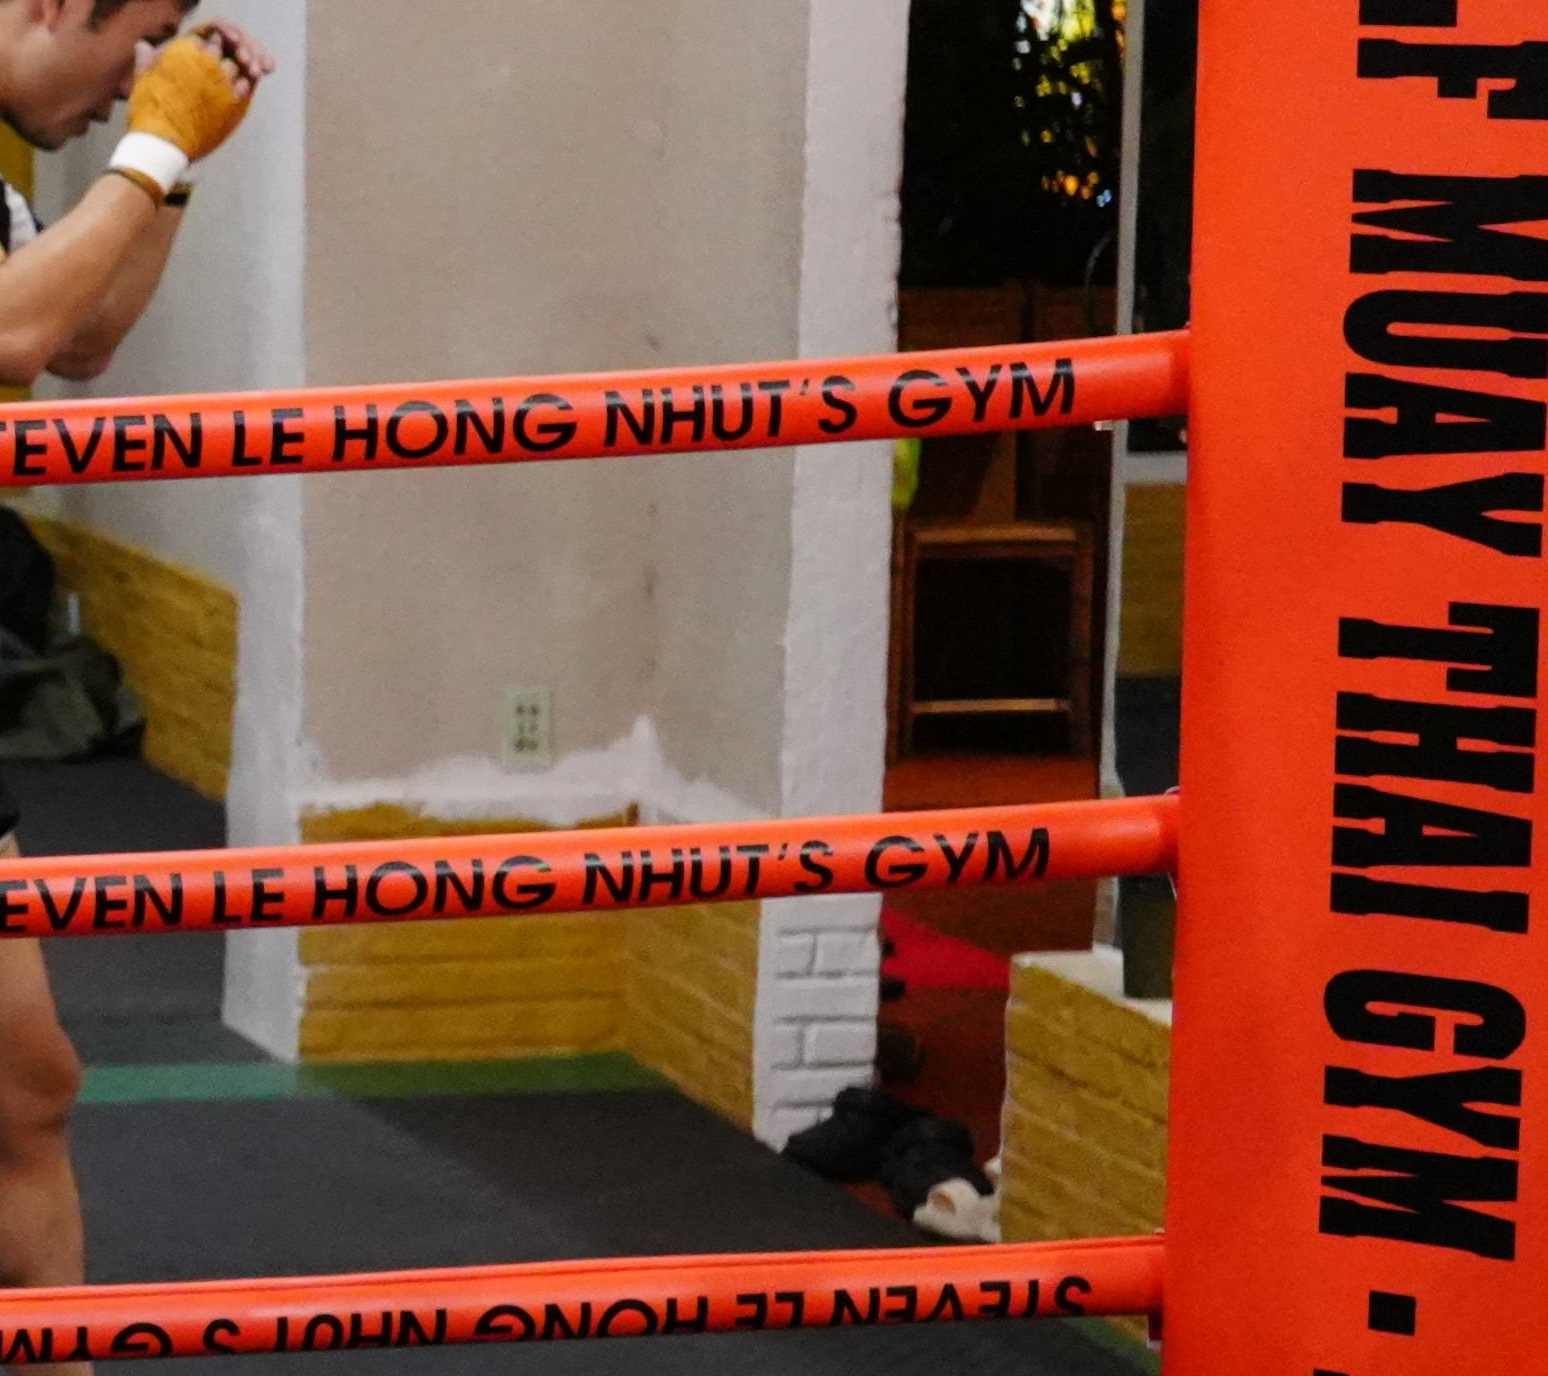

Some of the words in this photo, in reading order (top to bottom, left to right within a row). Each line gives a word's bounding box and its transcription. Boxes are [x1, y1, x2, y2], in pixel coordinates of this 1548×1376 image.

[231, 406, 306, 468] LE
[332, 393, 578, 460] HONG
[604, 376, 858, 447] NHUT'S
[887, 358, 1076, 427] GYM
[1340, 168, 1548, 559] MUAY
[210, 867, 287, 929] LE
[310, 855, 558, 919] HONG
[582, 838, 835, 907] NHUT'S
[863, 827, 1052, 891] GYM
[1329, 601, 1542, 936] THAI
[1317, 968, 1527, 1262] GYM
